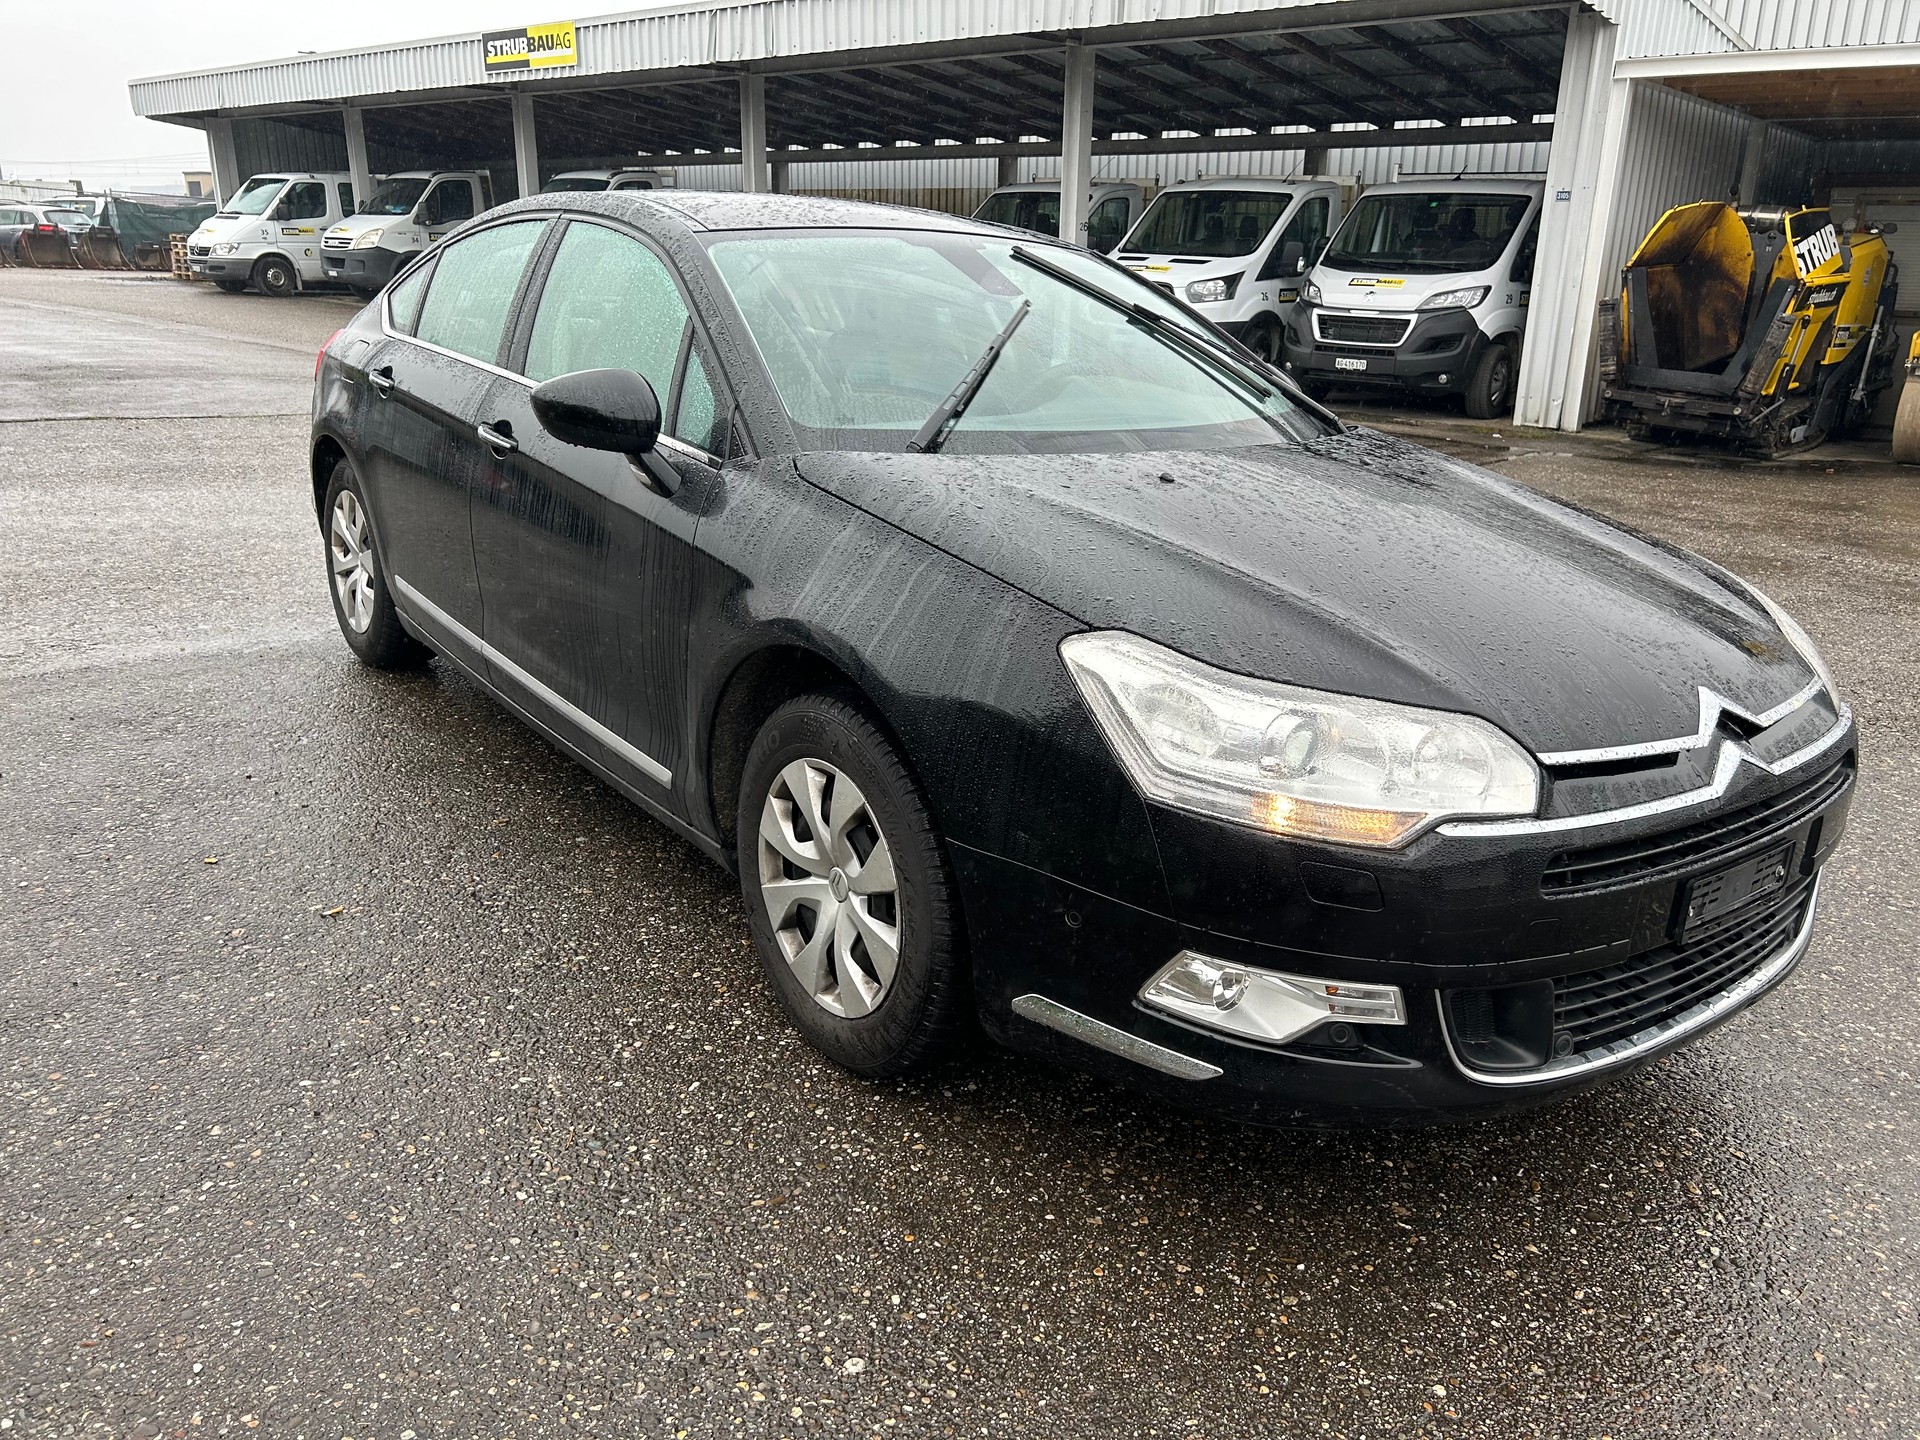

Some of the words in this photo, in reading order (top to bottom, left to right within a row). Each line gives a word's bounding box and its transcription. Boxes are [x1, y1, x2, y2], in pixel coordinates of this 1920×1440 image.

[1794, 224, 1840, 279] STRUB
[1261, 292, 1269, 301] 26
[1506, 294, 1513, 304] 29
